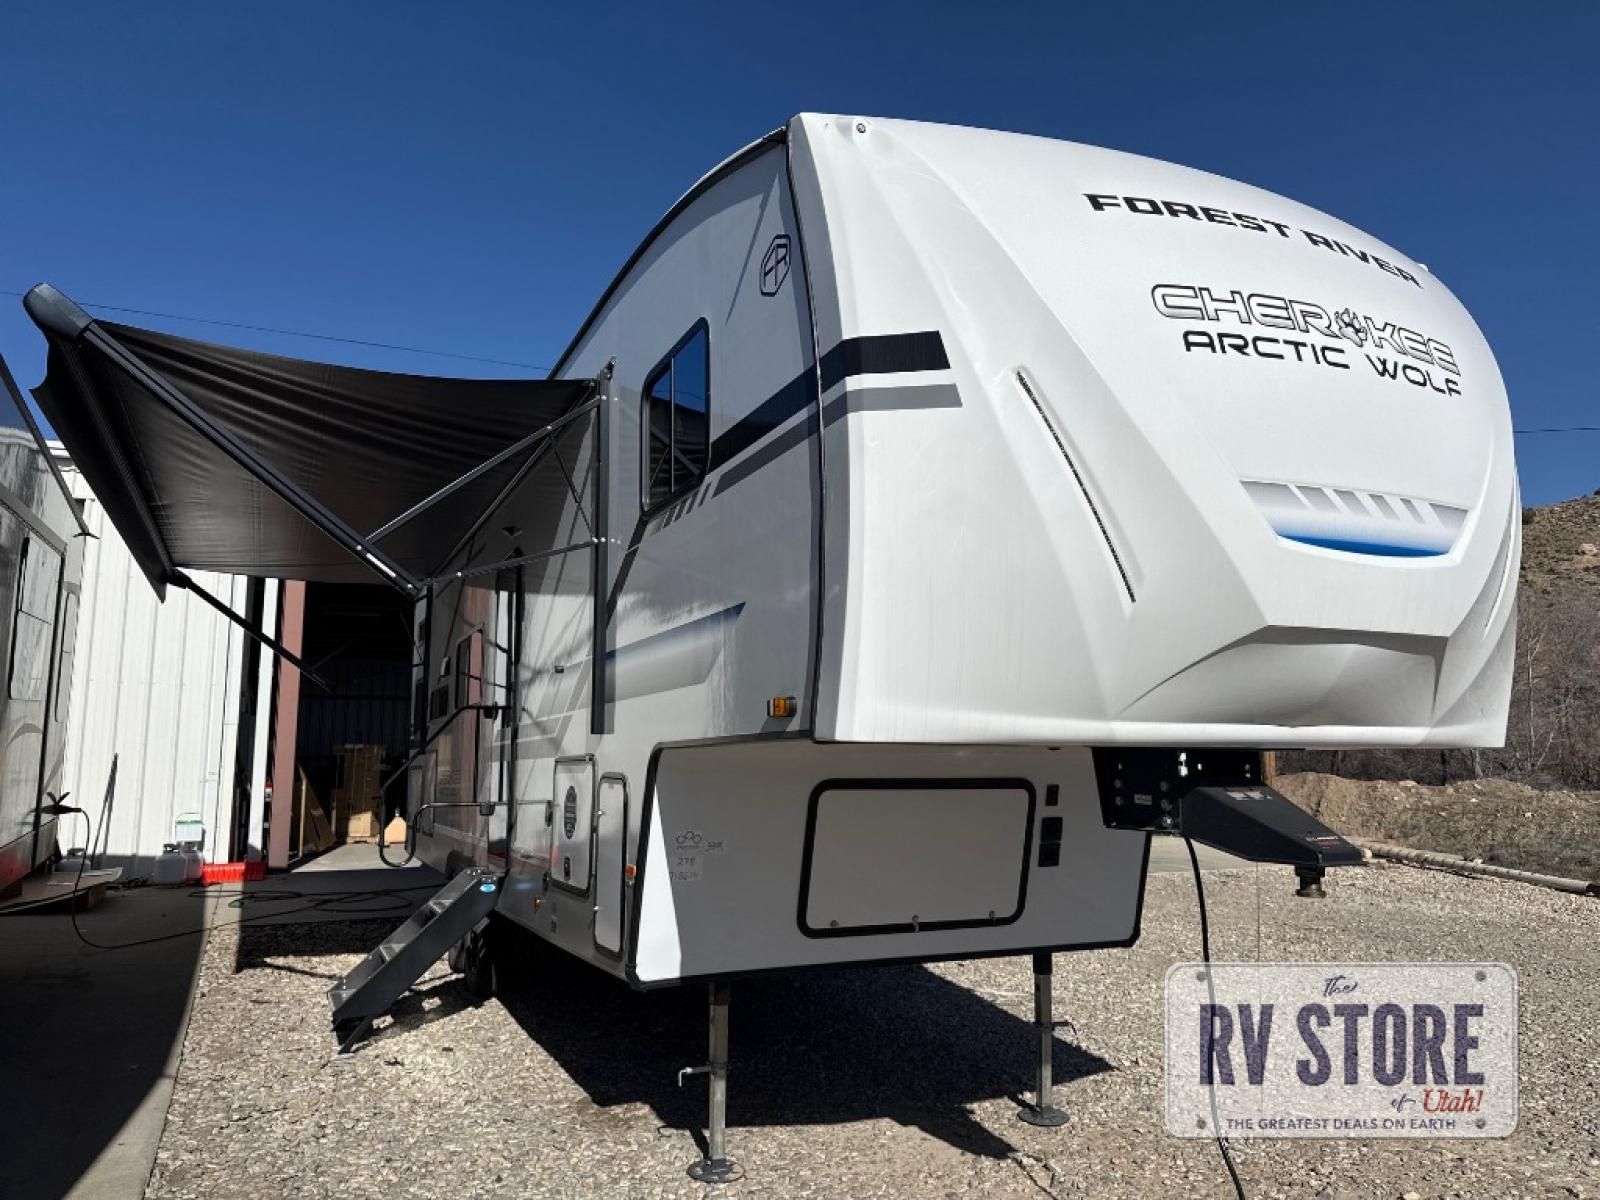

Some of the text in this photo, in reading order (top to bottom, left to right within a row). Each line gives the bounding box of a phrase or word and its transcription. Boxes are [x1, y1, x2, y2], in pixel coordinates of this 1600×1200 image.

[1083, 194, 1423, 289] FOREST RIVER
[1183, 330, 1462, 396] ARCTIC WOLF
